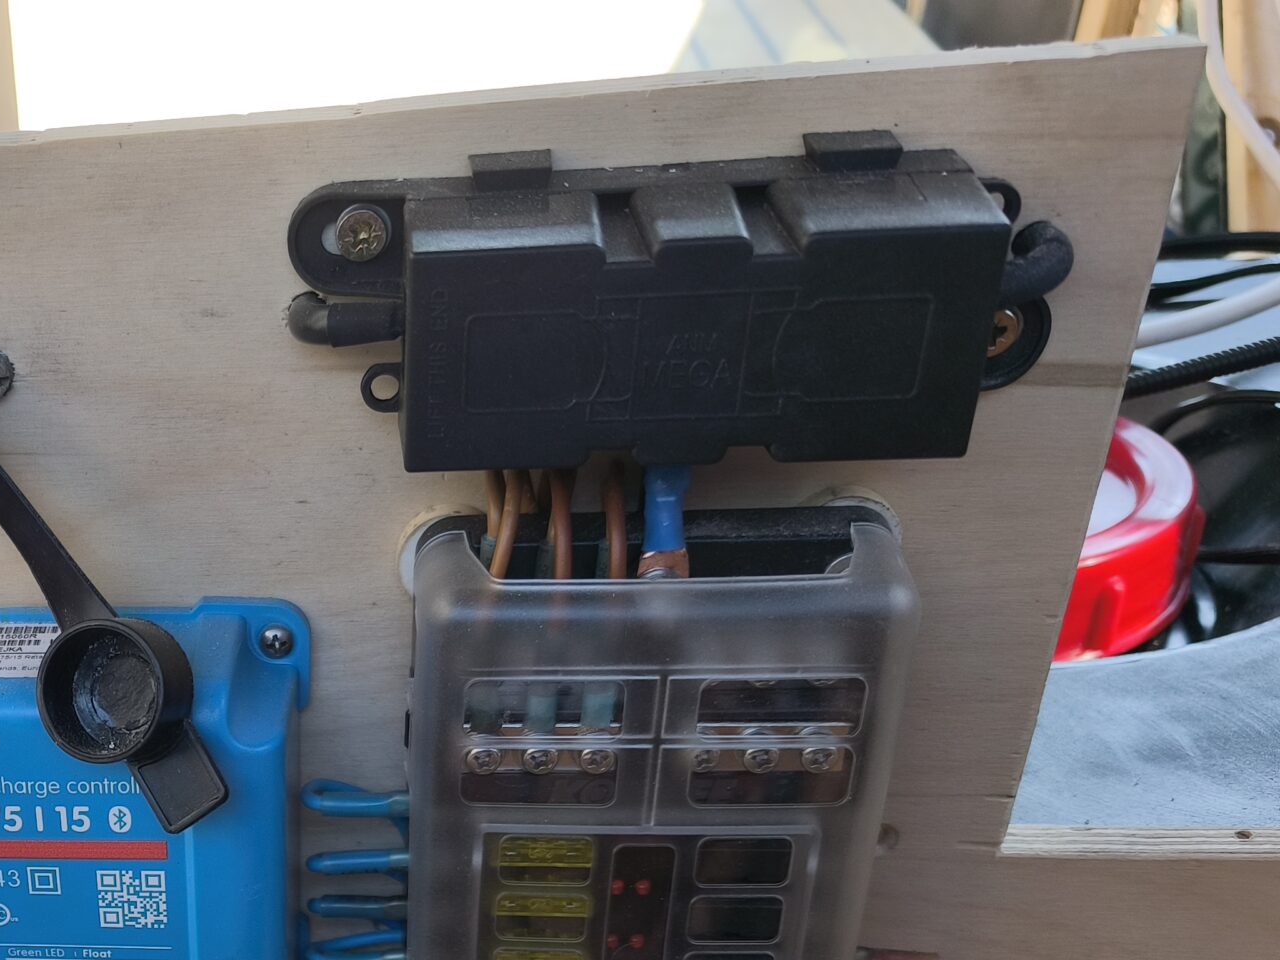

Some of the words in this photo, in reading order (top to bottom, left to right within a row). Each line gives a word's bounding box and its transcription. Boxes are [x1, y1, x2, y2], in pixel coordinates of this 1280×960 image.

[66, 776, 142, 795] controll
[54, 805, 91, 833] 15
[7, 947, 42, 957] Green
[45, 948, 65, 957] LED
[82, 949, 112, 958] Float
